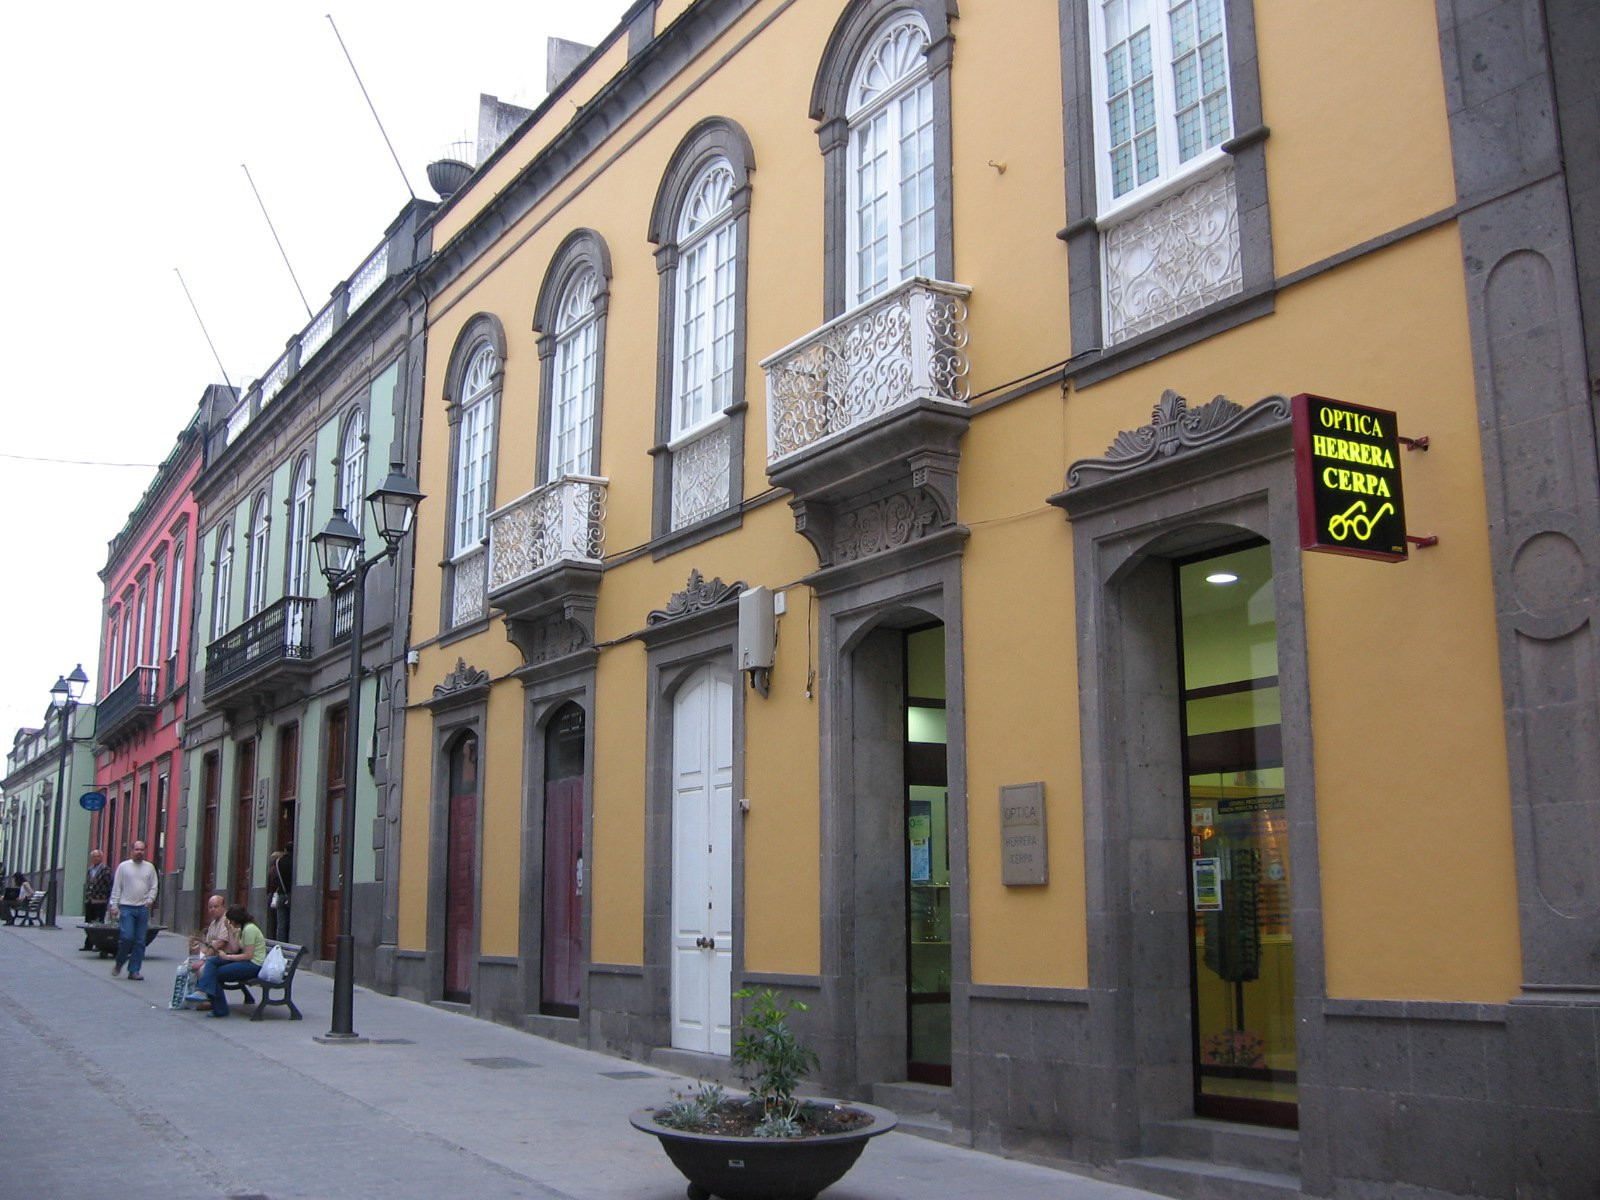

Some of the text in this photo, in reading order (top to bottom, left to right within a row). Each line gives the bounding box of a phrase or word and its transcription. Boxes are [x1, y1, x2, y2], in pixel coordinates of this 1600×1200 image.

[1320, 407, 1383, 437] OPTICA
[1313, 435, 1394, 469] HERRERA
[1323, 467, 1391, 497] CERPA
